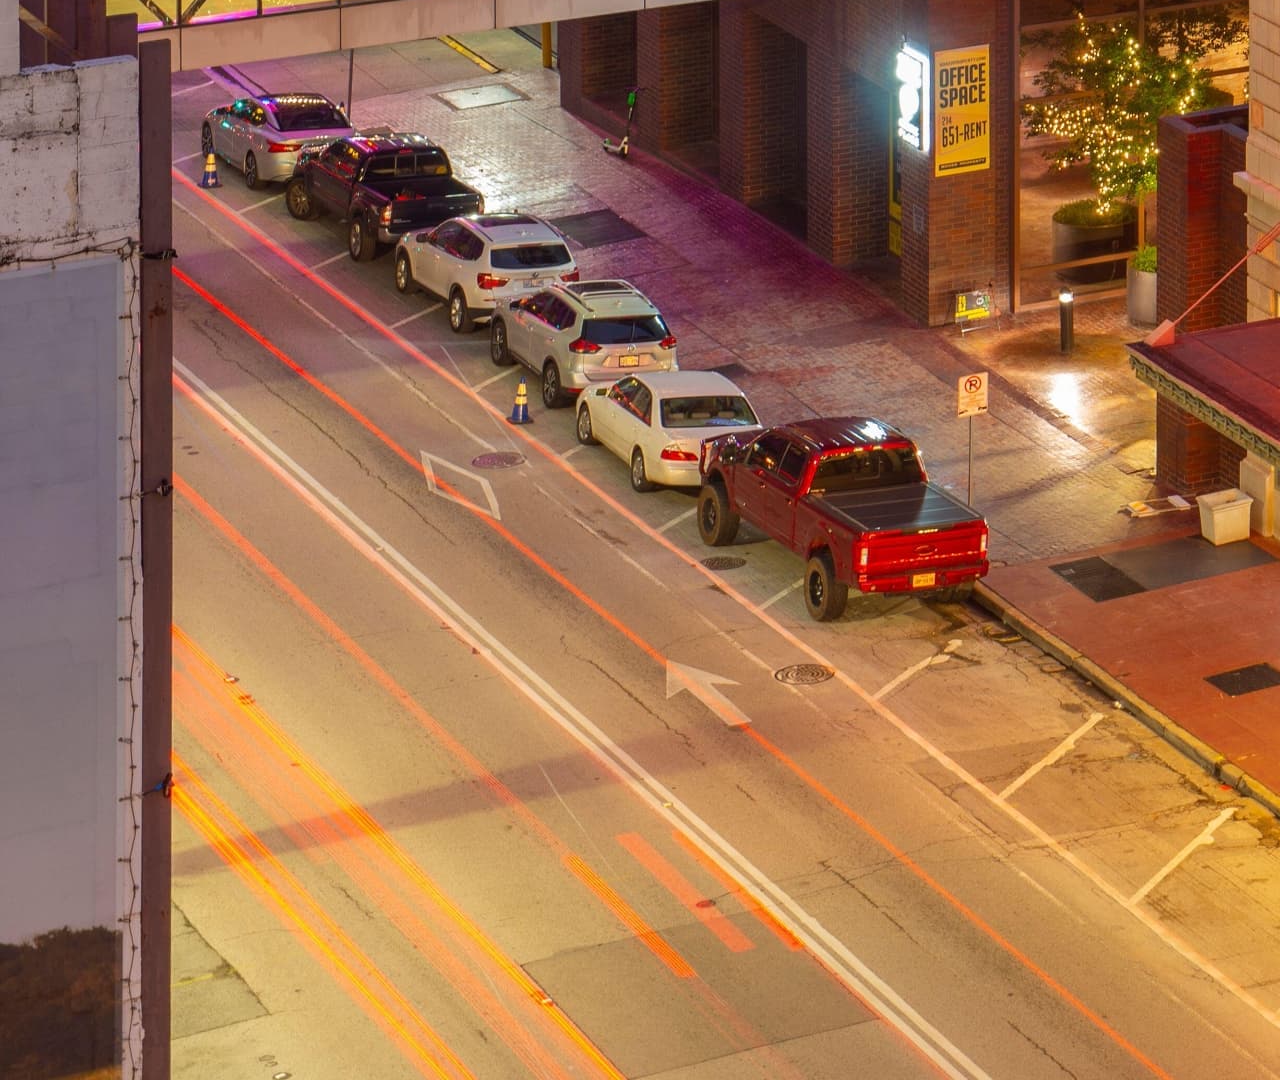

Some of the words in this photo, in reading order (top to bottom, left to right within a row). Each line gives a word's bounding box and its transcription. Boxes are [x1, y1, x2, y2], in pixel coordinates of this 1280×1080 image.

[939, 62, 986, 88] OFFICE
[939, 83, 986, 109] SPACE
[942, 120, 987, 148] 651-RENT
